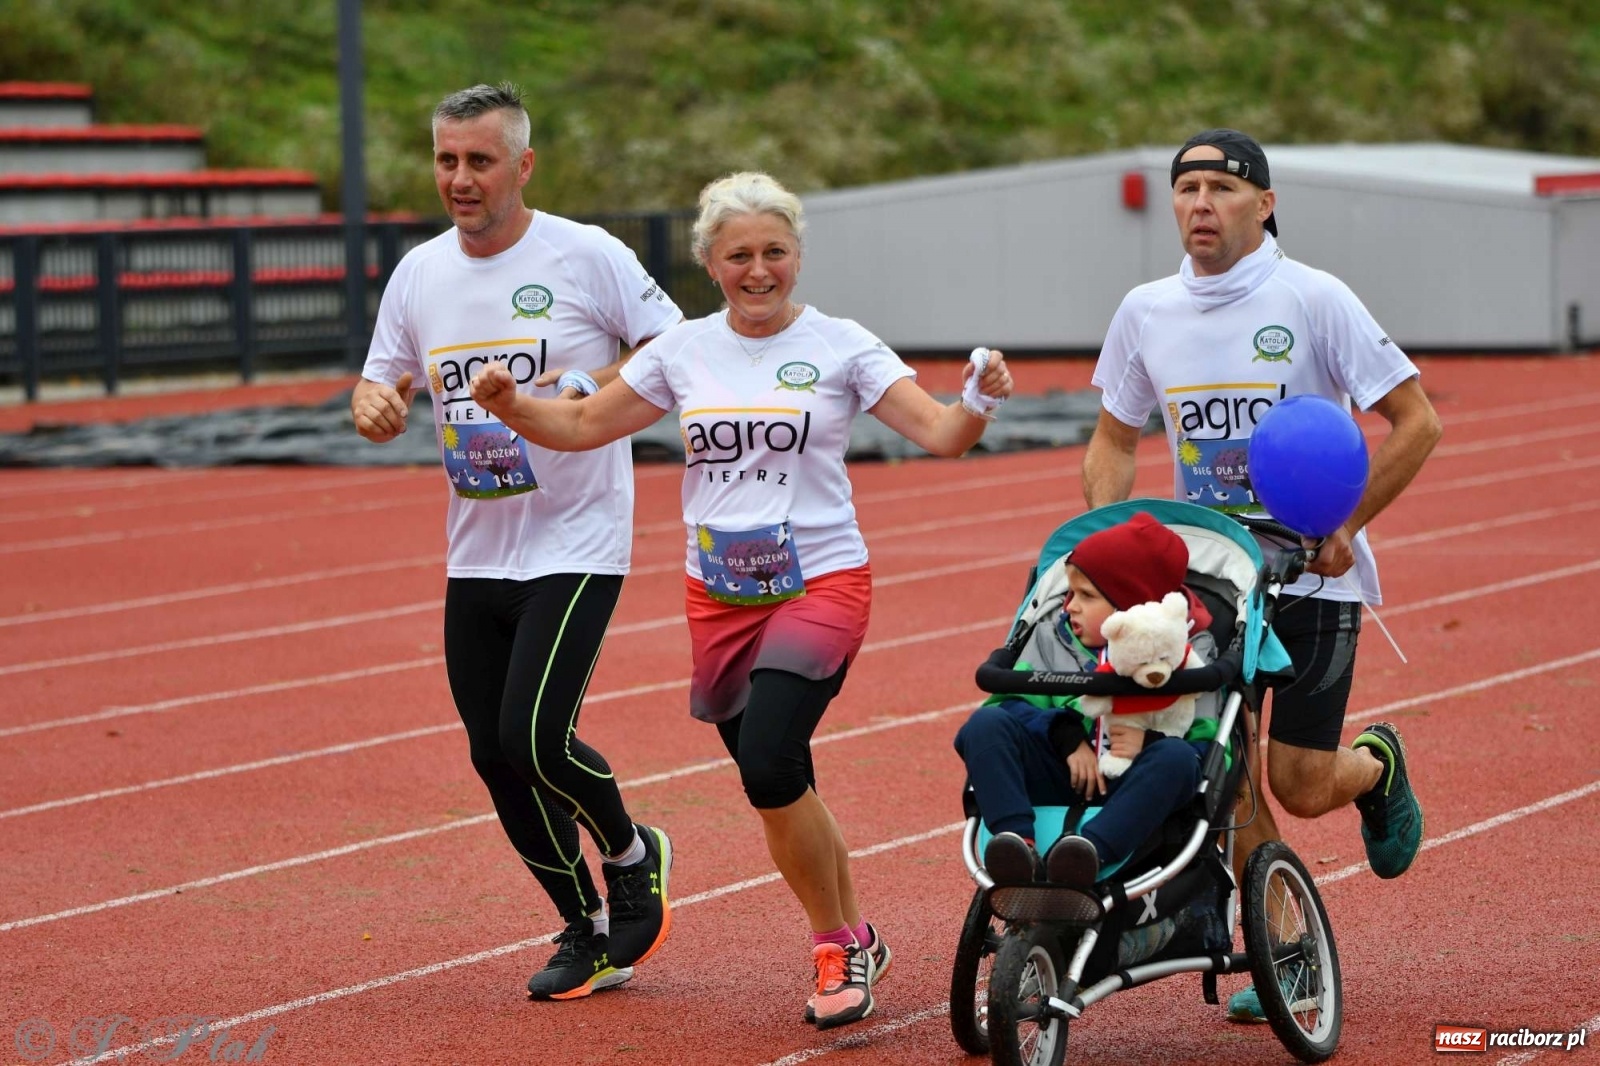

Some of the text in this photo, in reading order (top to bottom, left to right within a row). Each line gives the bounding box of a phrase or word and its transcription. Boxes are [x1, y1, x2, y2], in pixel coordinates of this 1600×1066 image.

[687, 411, 811, 468] agrol
[452, 450, 467, 460] BIEG
[469, 451, 482, 460] DLA
[701, 469, 788, 486] IETRZ
[1192, 466, 1212, 476] BIEG
[1216, 466, 1233, 475] DLA
[492, 471, 525, 488] 142
[707, 554, 724, 566] BIEG
[727, 557, 745, 567] DLA
[757, 575, 794, 596] 280
[1028, 671, 1093, 684] X-lander
